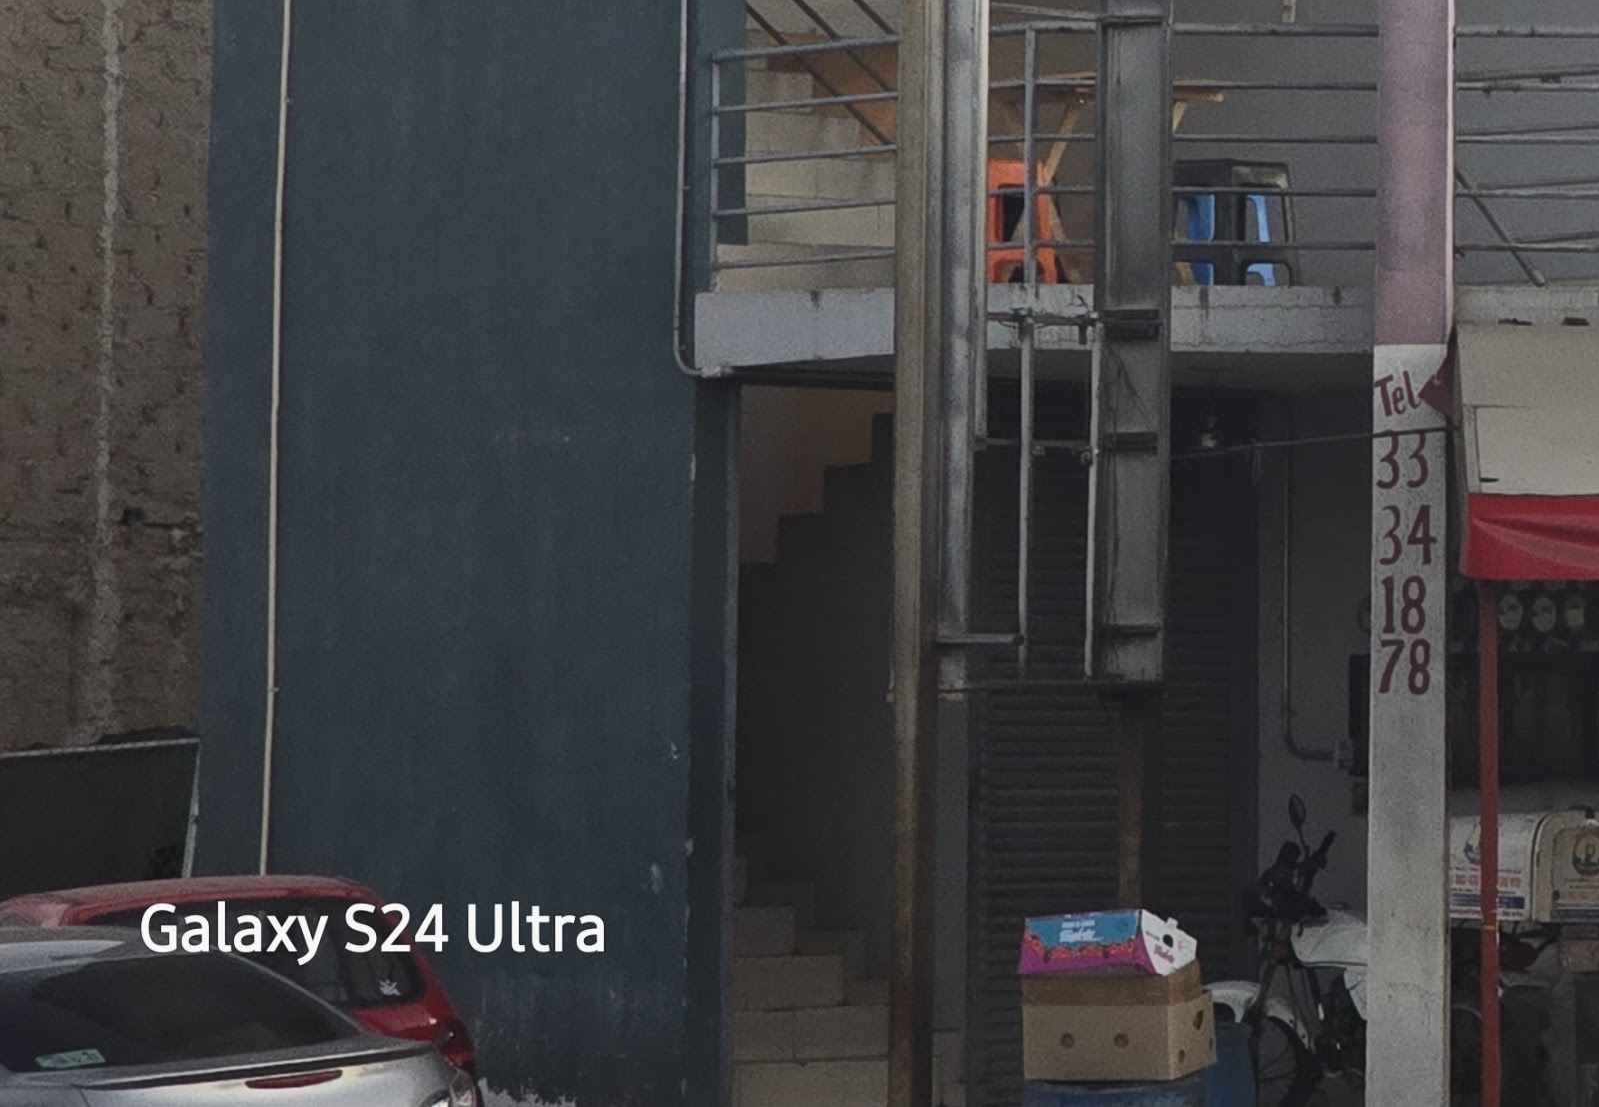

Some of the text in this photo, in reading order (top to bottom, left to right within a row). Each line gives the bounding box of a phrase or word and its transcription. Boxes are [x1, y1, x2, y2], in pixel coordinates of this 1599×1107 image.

[1374, 369, 1422, 418] Tel
[1375, 430, 1430, 490] 33
[1378, 504, 1438, 566] 34
[1380, 574, 1427, 635] 18
[1378, 638, 1431, 695] 78
